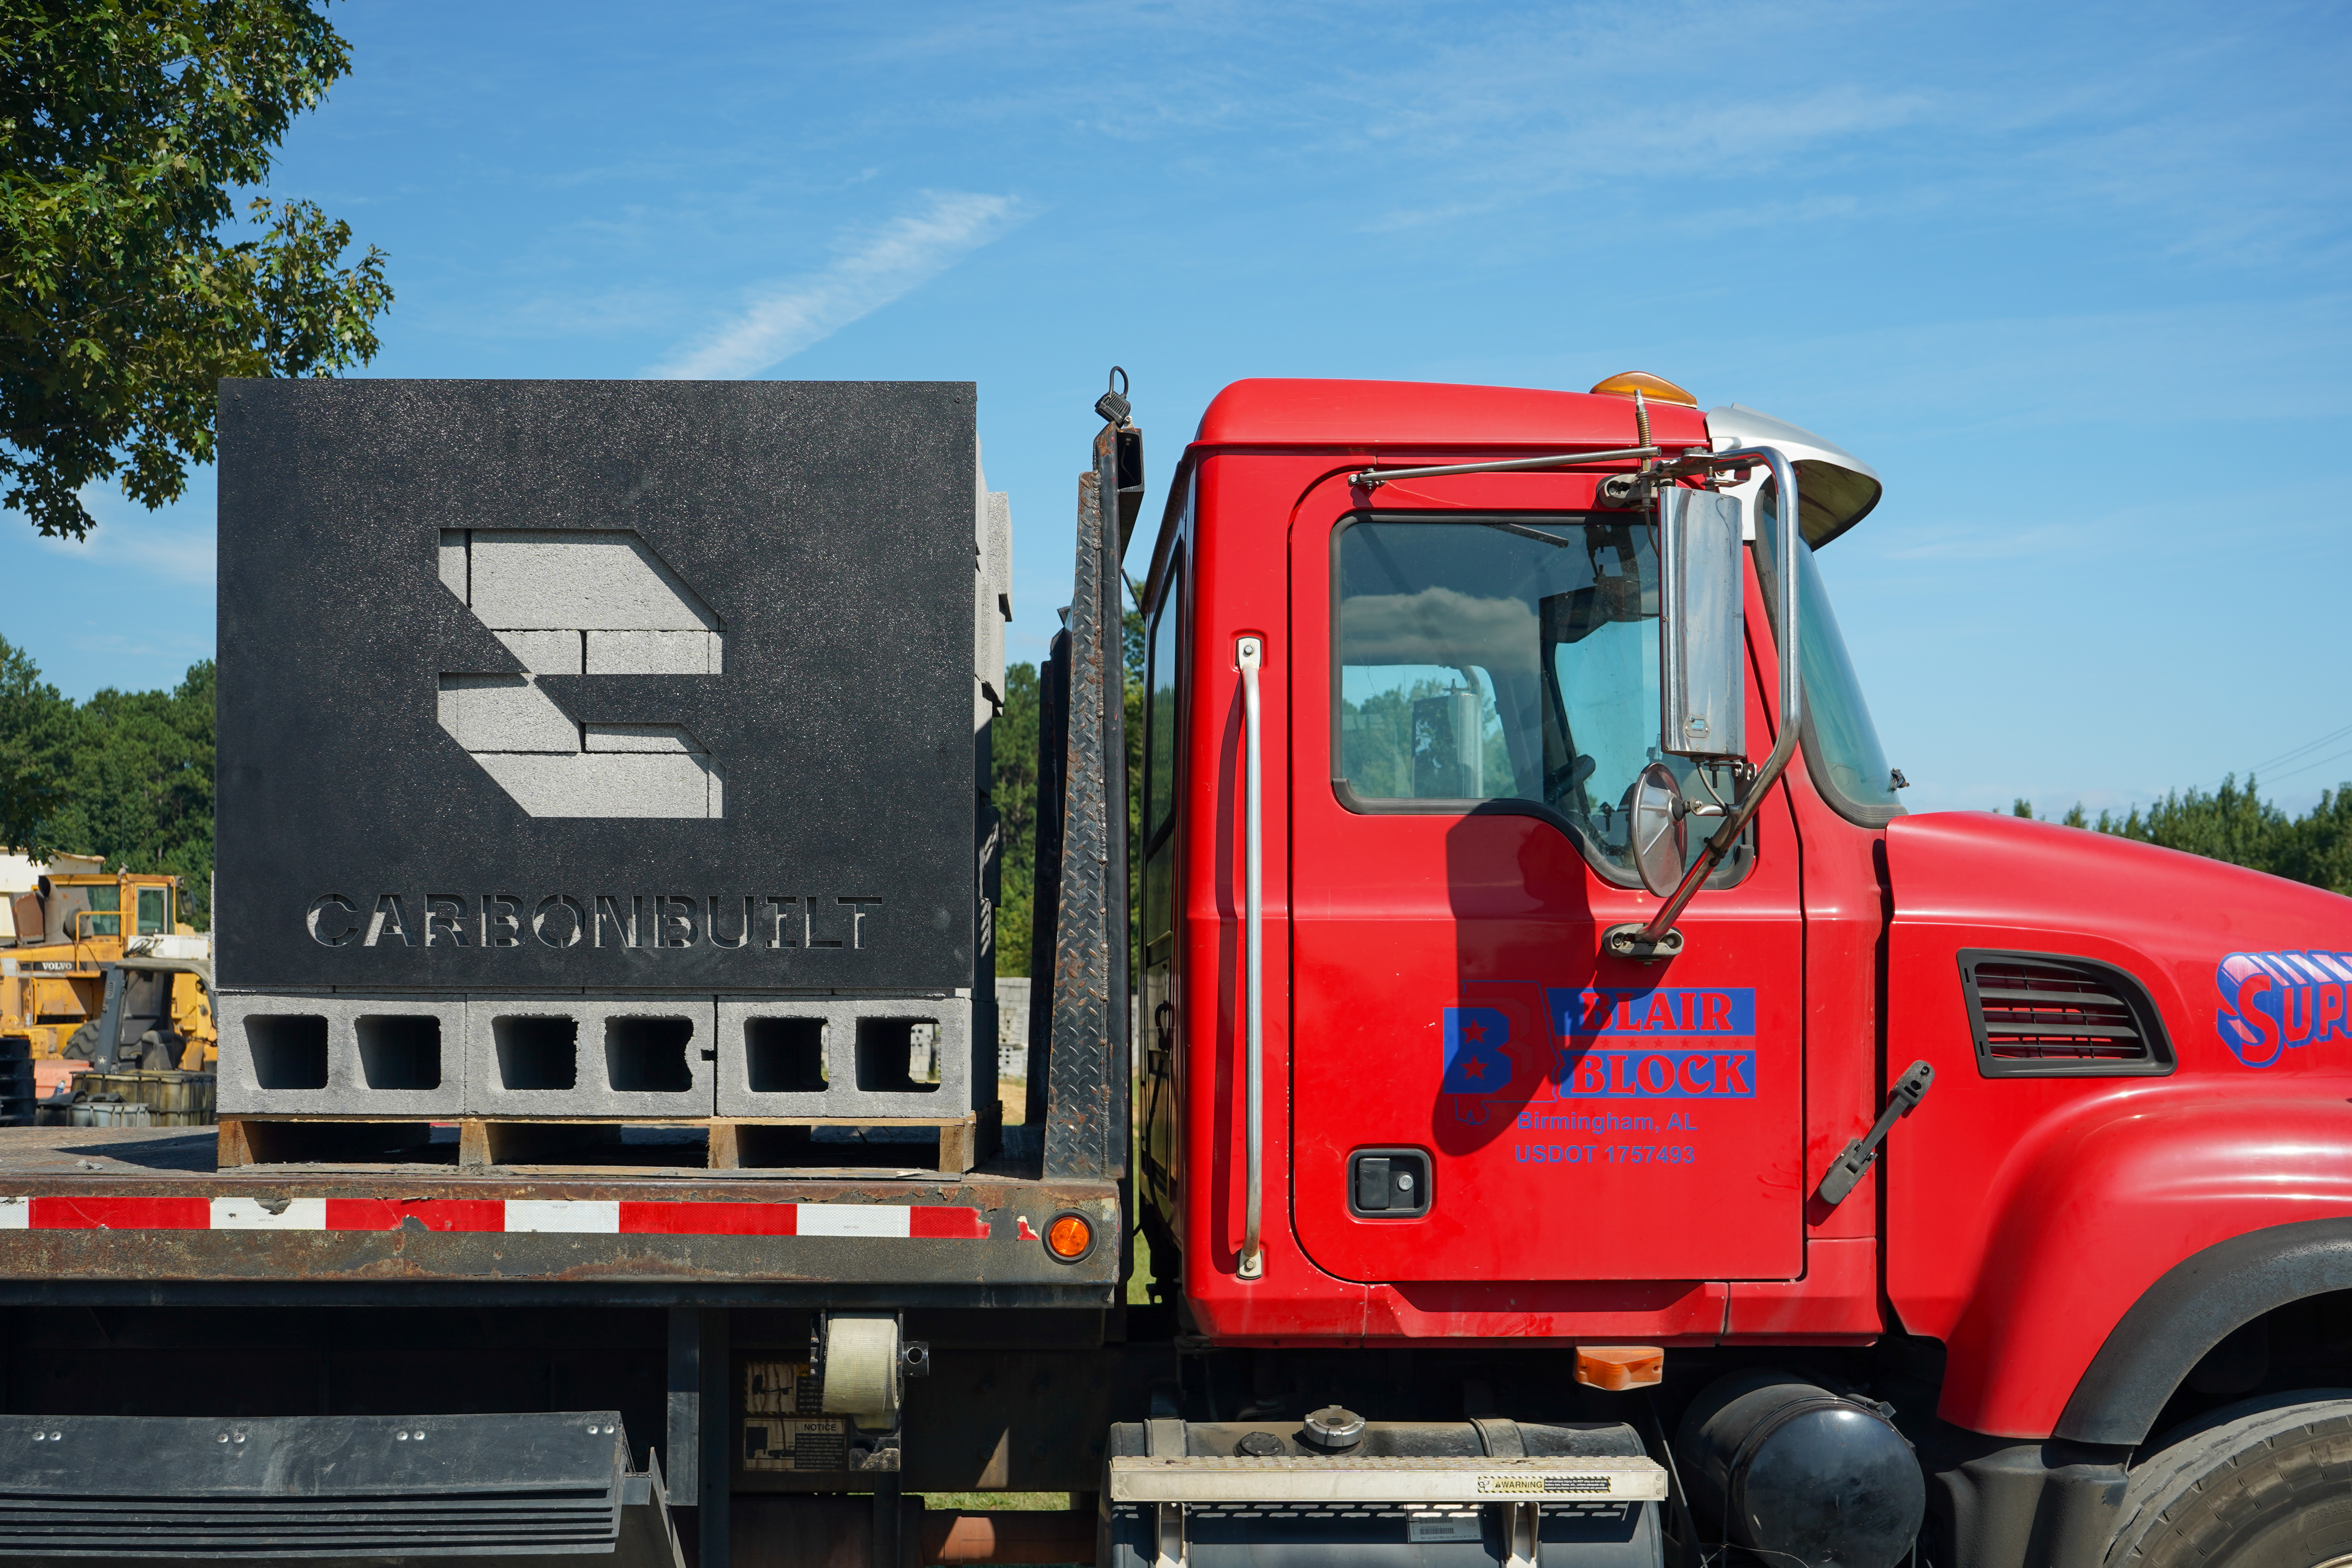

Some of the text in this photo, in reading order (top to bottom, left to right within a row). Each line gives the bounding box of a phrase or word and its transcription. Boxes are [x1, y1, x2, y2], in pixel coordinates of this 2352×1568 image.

[306, 893, 883, 948] CARBONBUILT
[42, 962, 72, 970] VOLVO
[1581, 993, 1733, 1031] BLAIR
[2229, 962, 2352, 1067] SUP
[1571, 1054, 1749, 1094] BLOCK
[1517, 1112, 1697, 1134] Birmingham, AL
[1515, 1145, 1695, 1163] USDOT 1757493
